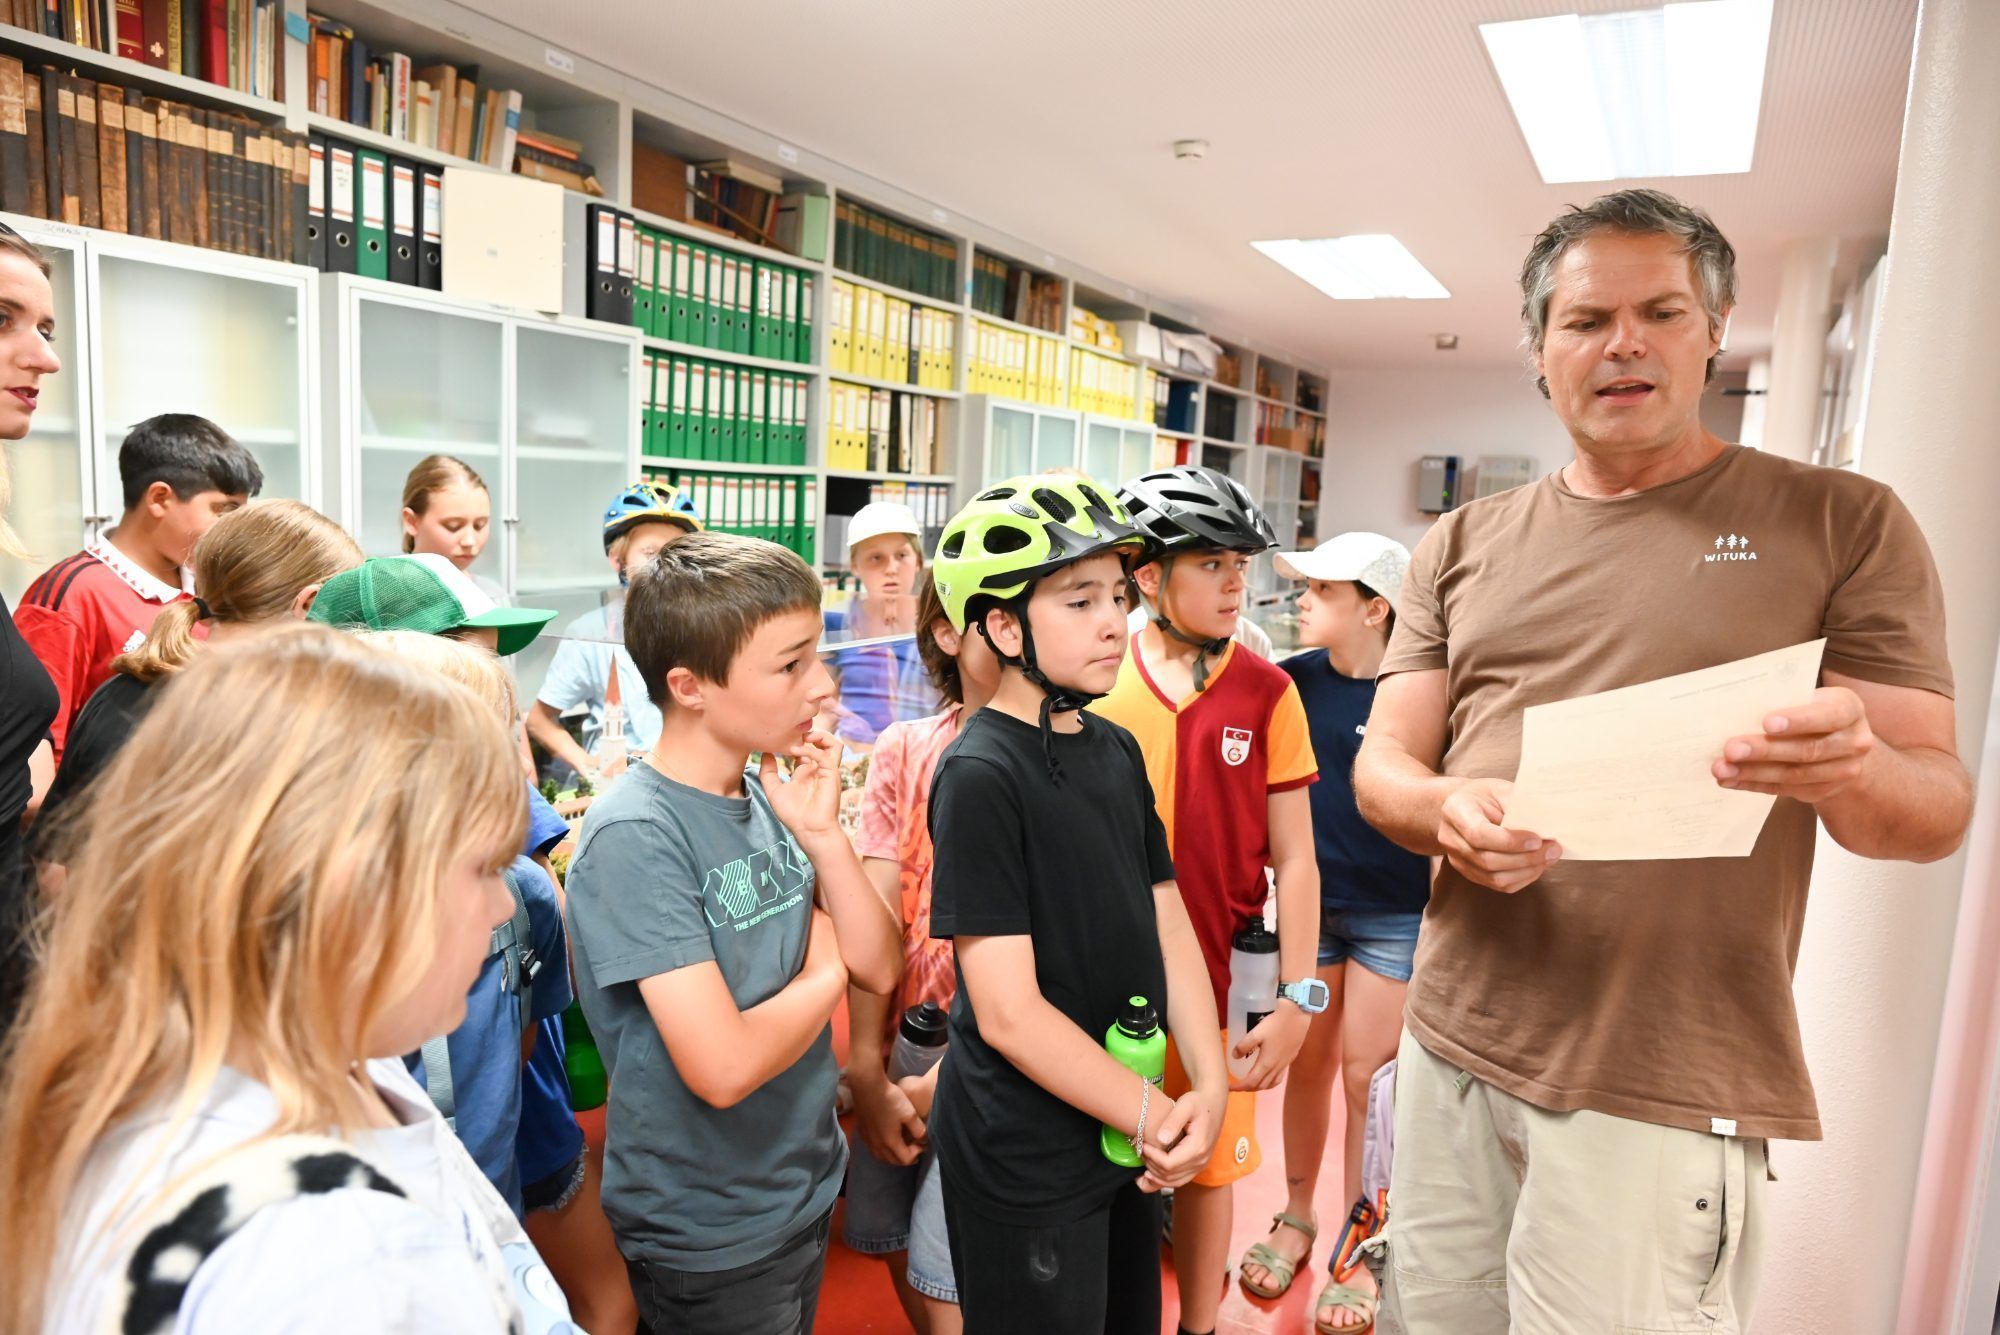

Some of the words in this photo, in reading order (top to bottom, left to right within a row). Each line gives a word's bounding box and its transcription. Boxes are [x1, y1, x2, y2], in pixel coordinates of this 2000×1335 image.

[1704, 551, 1758, 563] WITUKA
[734, 920, 750, 932] THE
[760, 893, 804, 920] GENERATION
